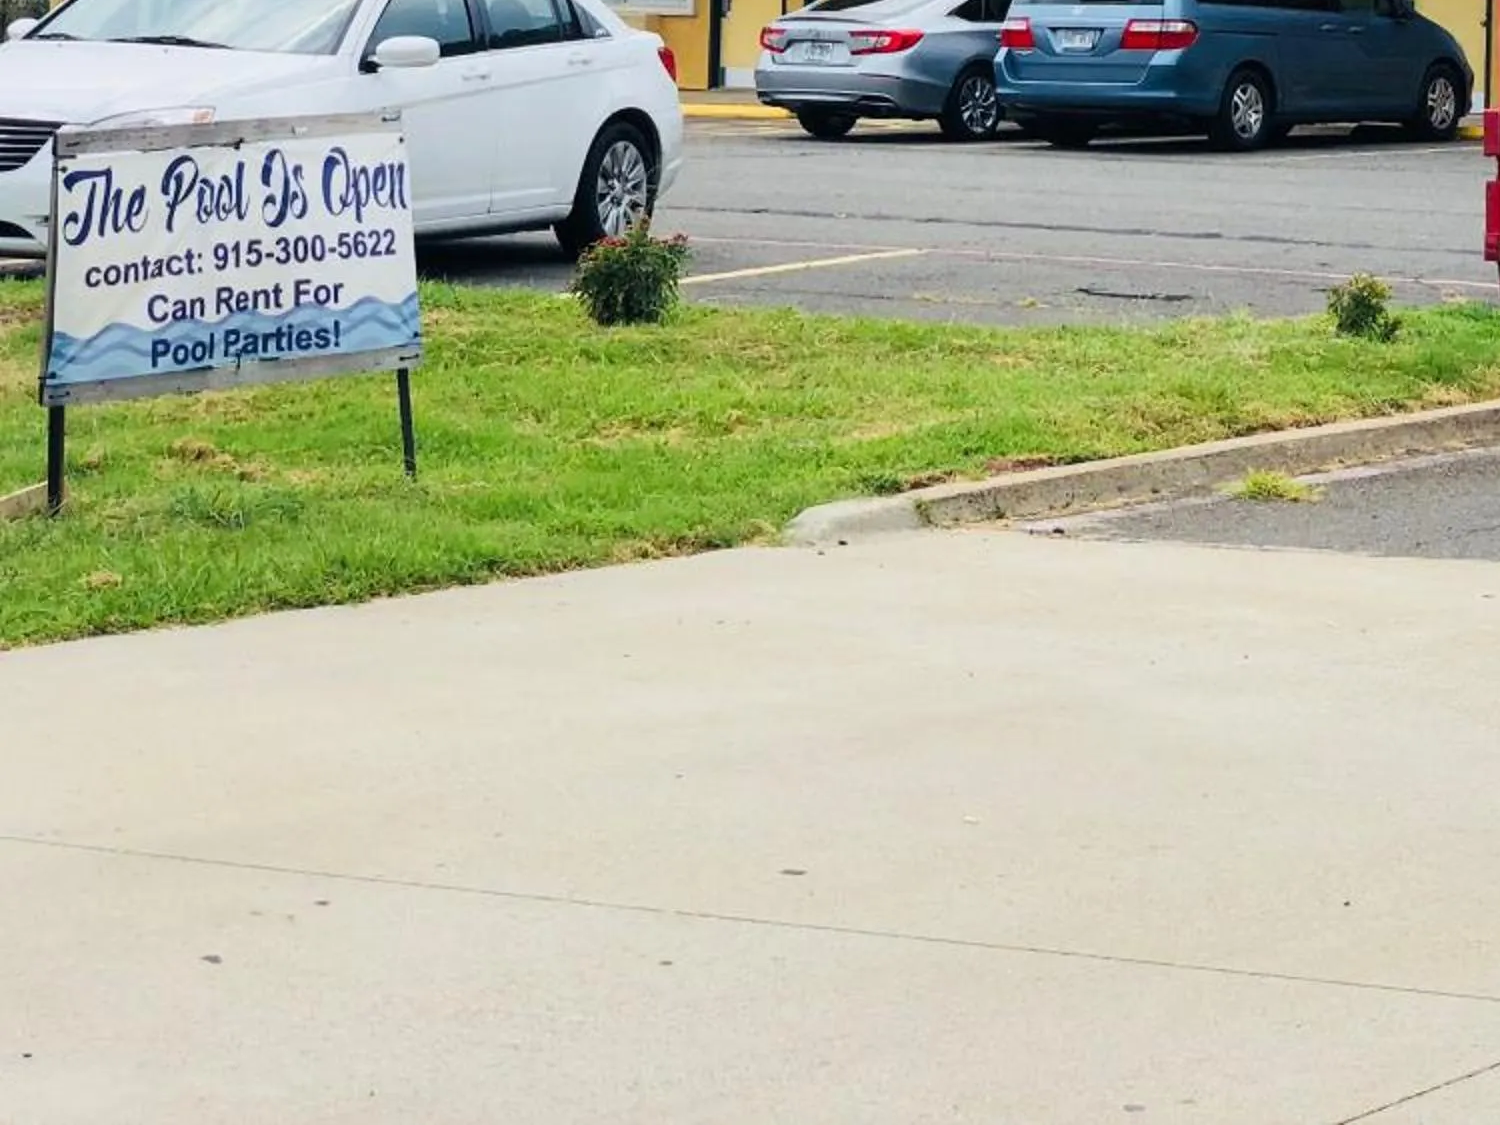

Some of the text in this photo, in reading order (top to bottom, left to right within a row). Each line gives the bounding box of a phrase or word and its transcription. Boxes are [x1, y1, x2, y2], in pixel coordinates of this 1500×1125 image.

[63, 146, 408, 246] The Pool Is Open
[85, 228, 397, 288] contact: 915-300-5622
[147, 278, 344, 323] Can Rent For
[151, 320, 341, 368] Pool Parties!
